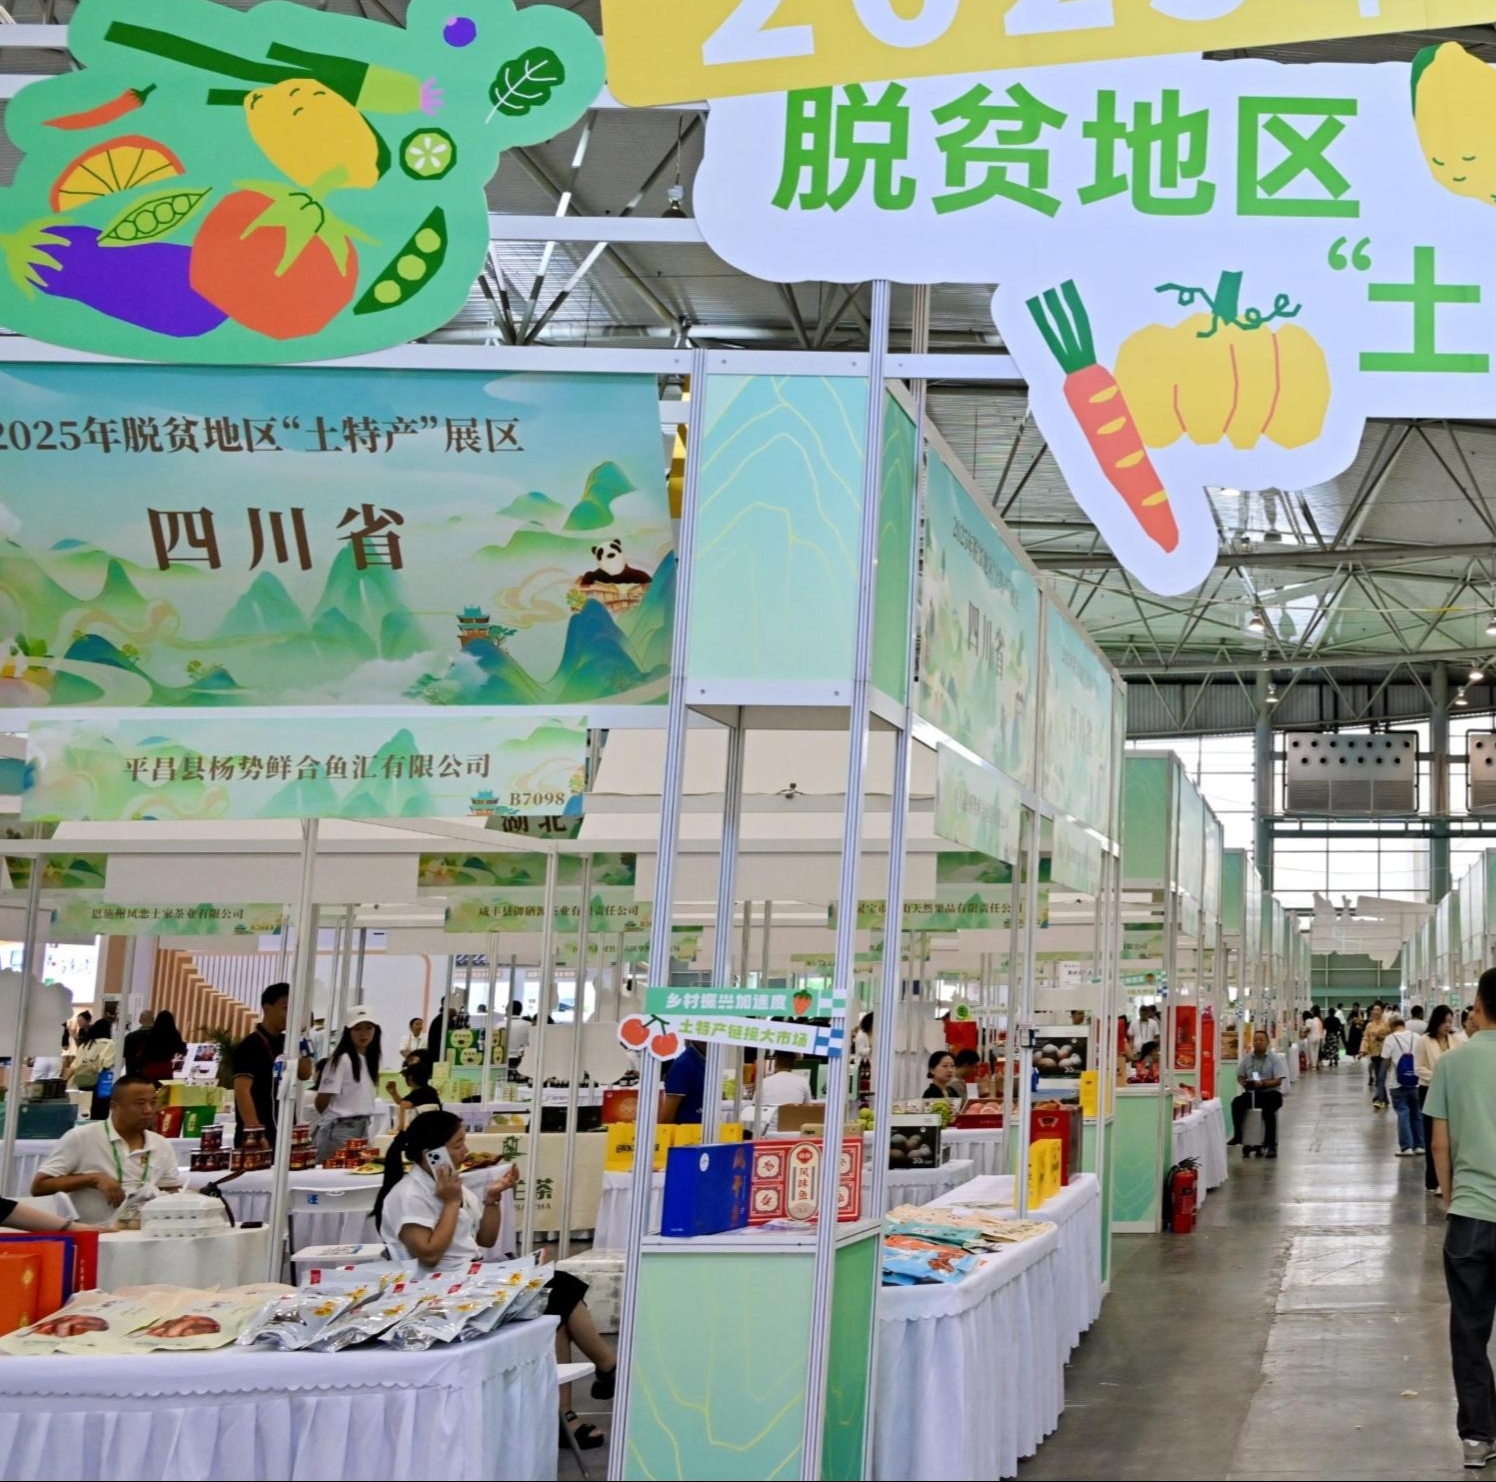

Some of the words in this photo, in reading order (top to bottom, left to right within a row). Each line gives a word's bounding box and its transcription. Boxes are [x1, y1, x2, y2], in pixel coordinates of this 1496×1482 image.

[771, 82, 1361, 218] 脱贫地区
[148, 503, 405, 572] 四川省
[122, 753, 491, 783] 平昌县杨势鲜合鱼汇有限公司
[510, 792, 565, 806] B7098
[665, 992, 787, 1011] 乡村振兴加速度
[678, 1019, 808, 1048] 土特产链接大市场
